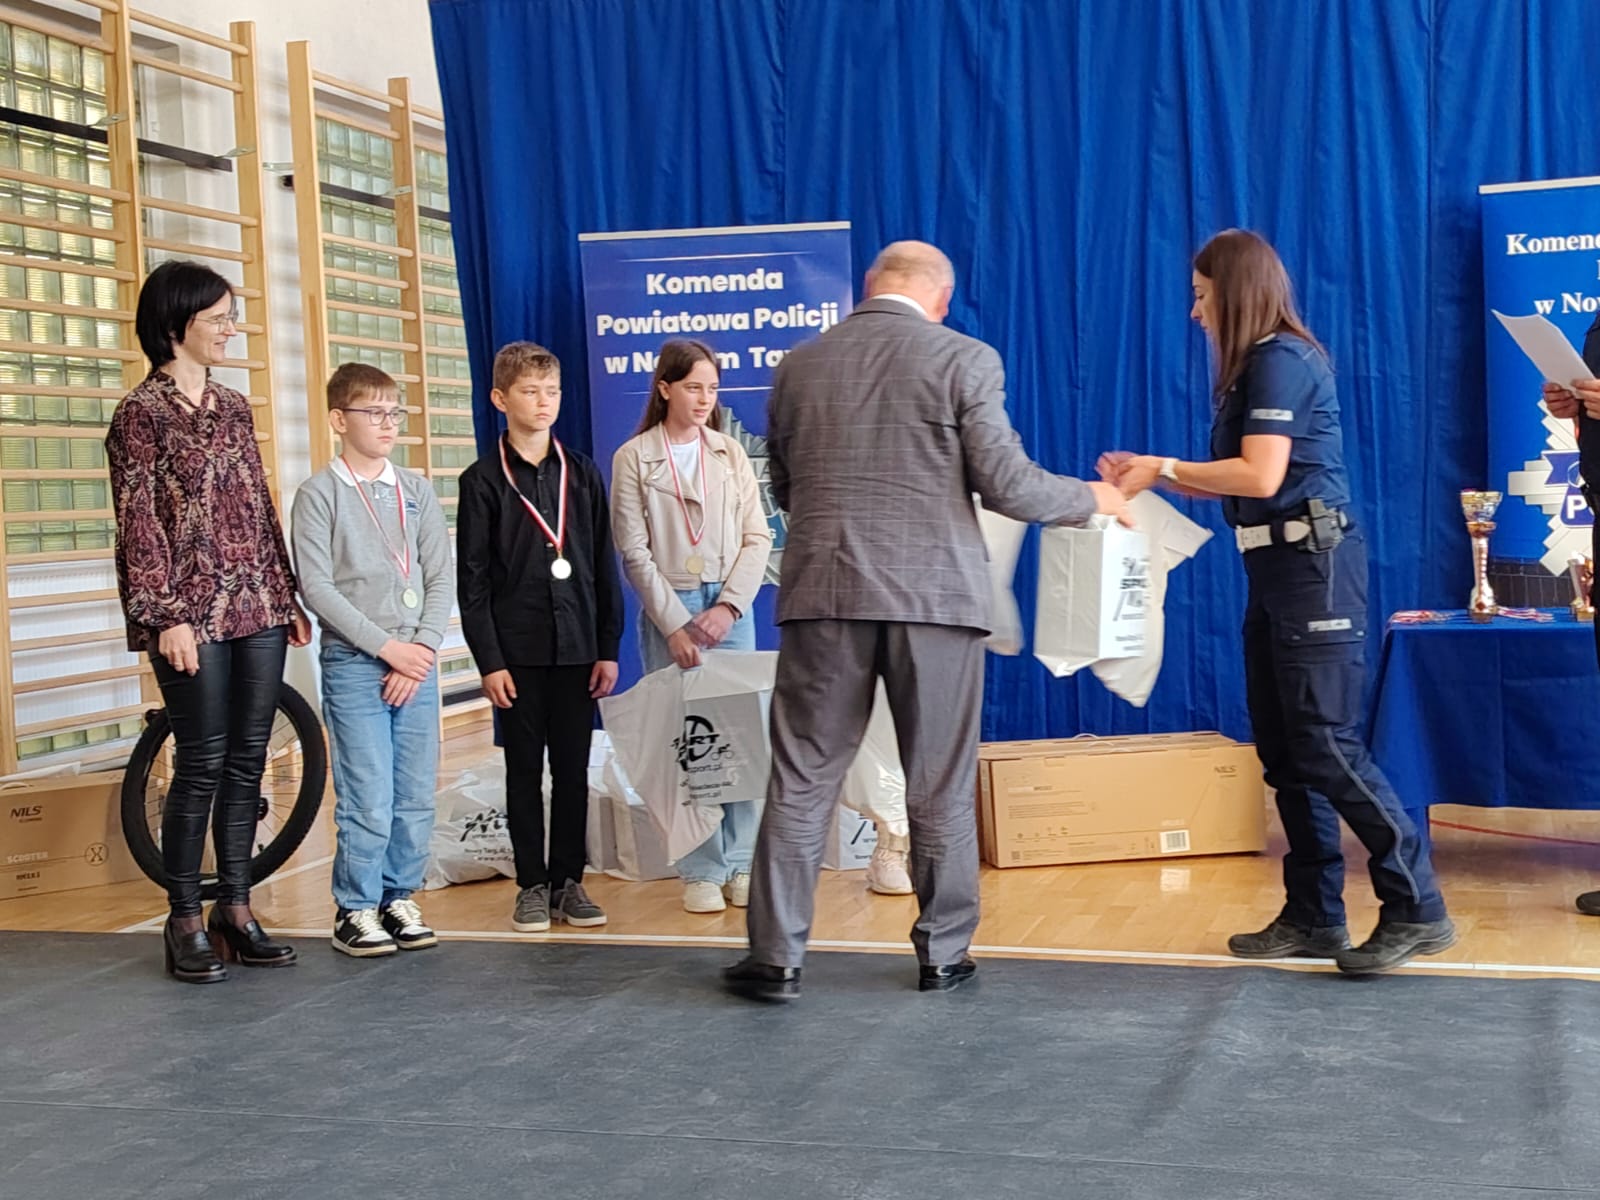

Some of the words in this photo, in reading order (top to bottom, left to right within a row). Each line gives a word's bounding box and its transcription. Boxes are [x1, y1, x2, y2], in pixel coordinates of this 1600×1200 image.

[646, 268, 784, 295] Komenda
[596, 309, 750, 336] Powiatowa
[754, 302, 839, 333] Policji
[1534, 299, 1555, 314] w
[604, 356, 629, 374] w
[748, 346, 791, 368] Ta
[10, 805, 42, 818] NILS
